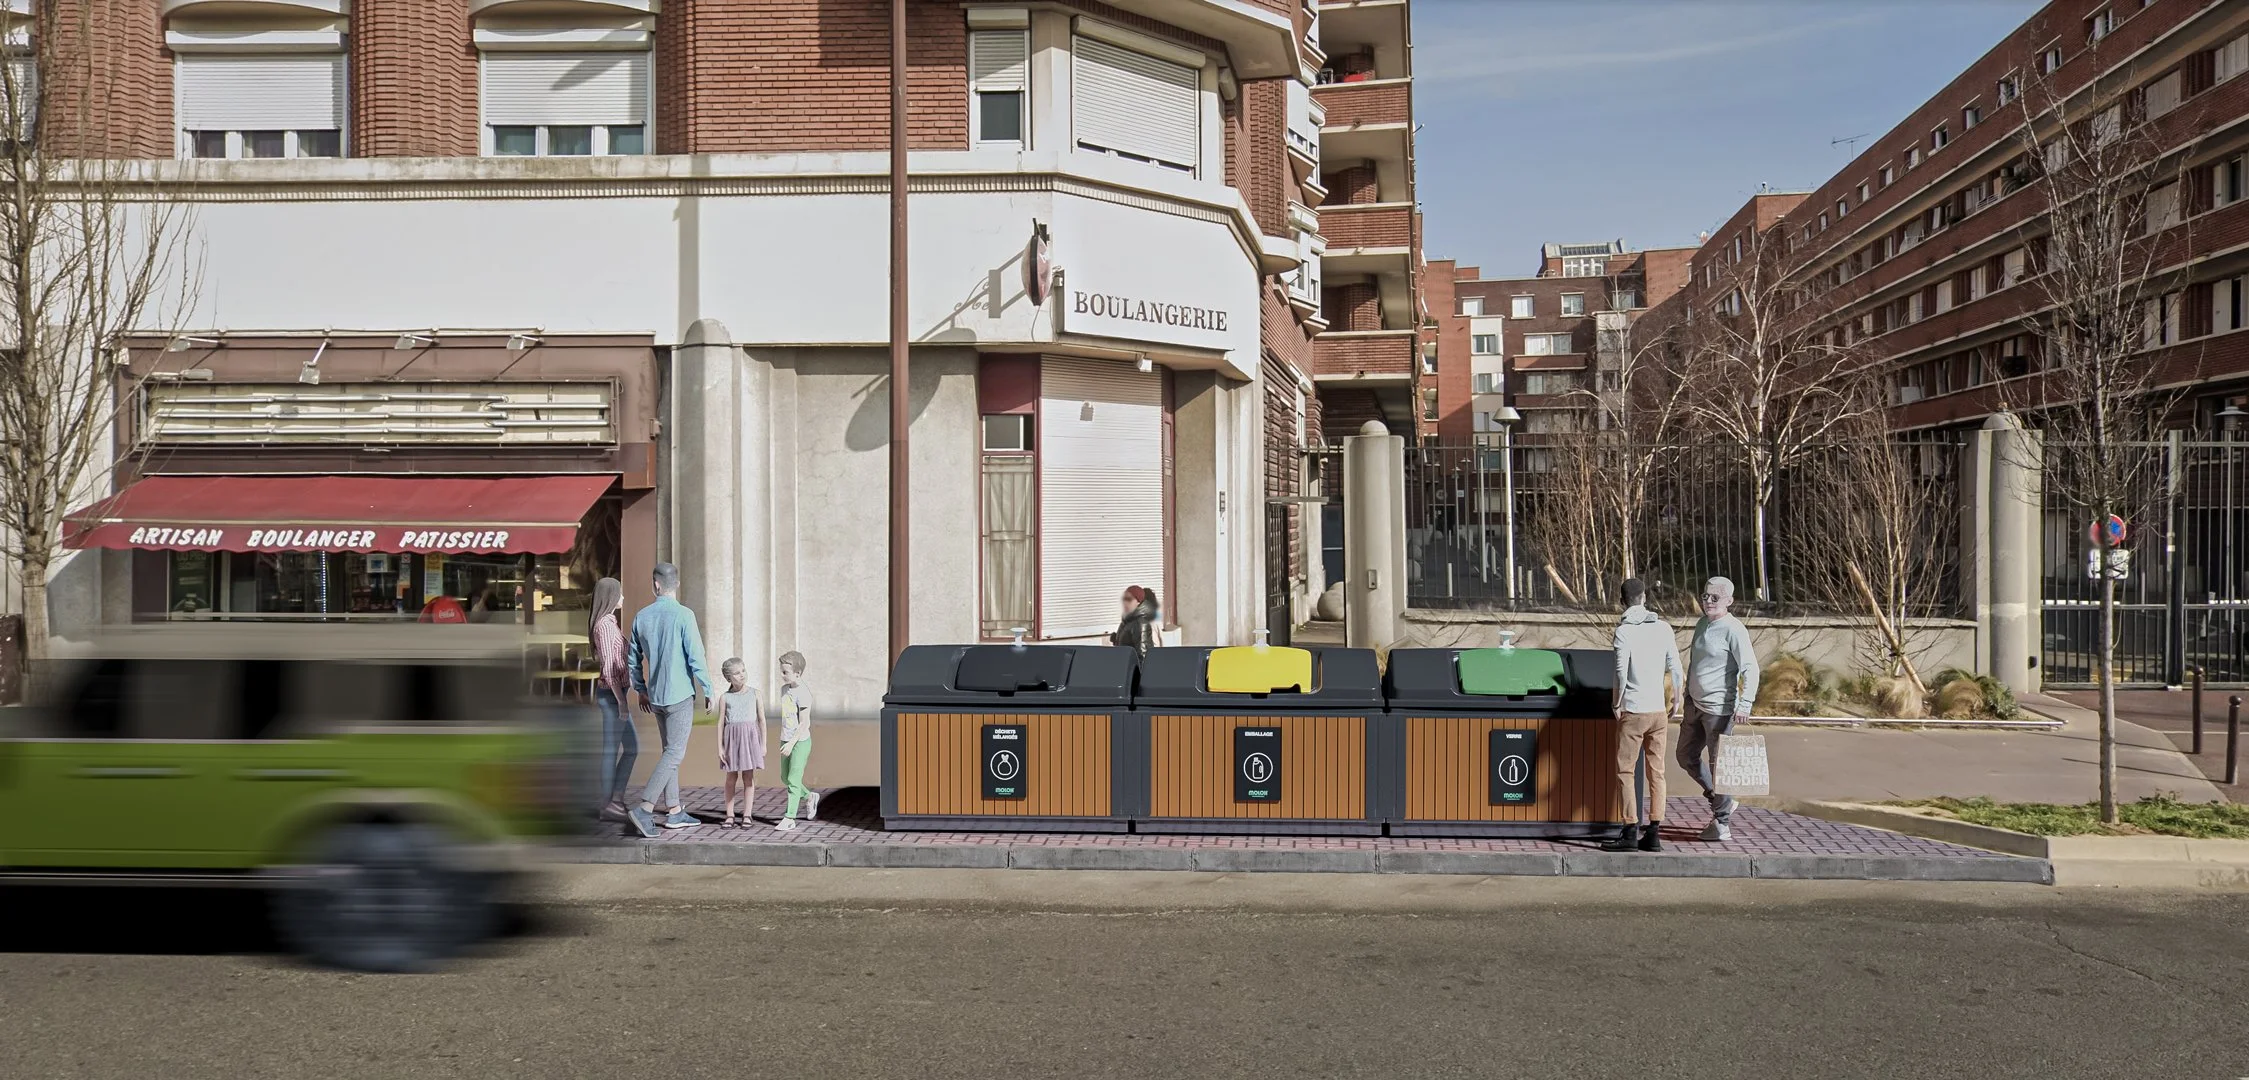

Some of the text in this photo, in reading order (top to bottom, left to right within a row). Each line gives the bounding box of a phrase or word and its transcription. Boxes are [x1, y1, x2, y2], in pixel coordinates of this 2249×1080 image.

[1074, 290, 1228, 332] BOULANGERIE
[129, 527, 509, 549] ARTISAN BOULANGER PATISSIER
